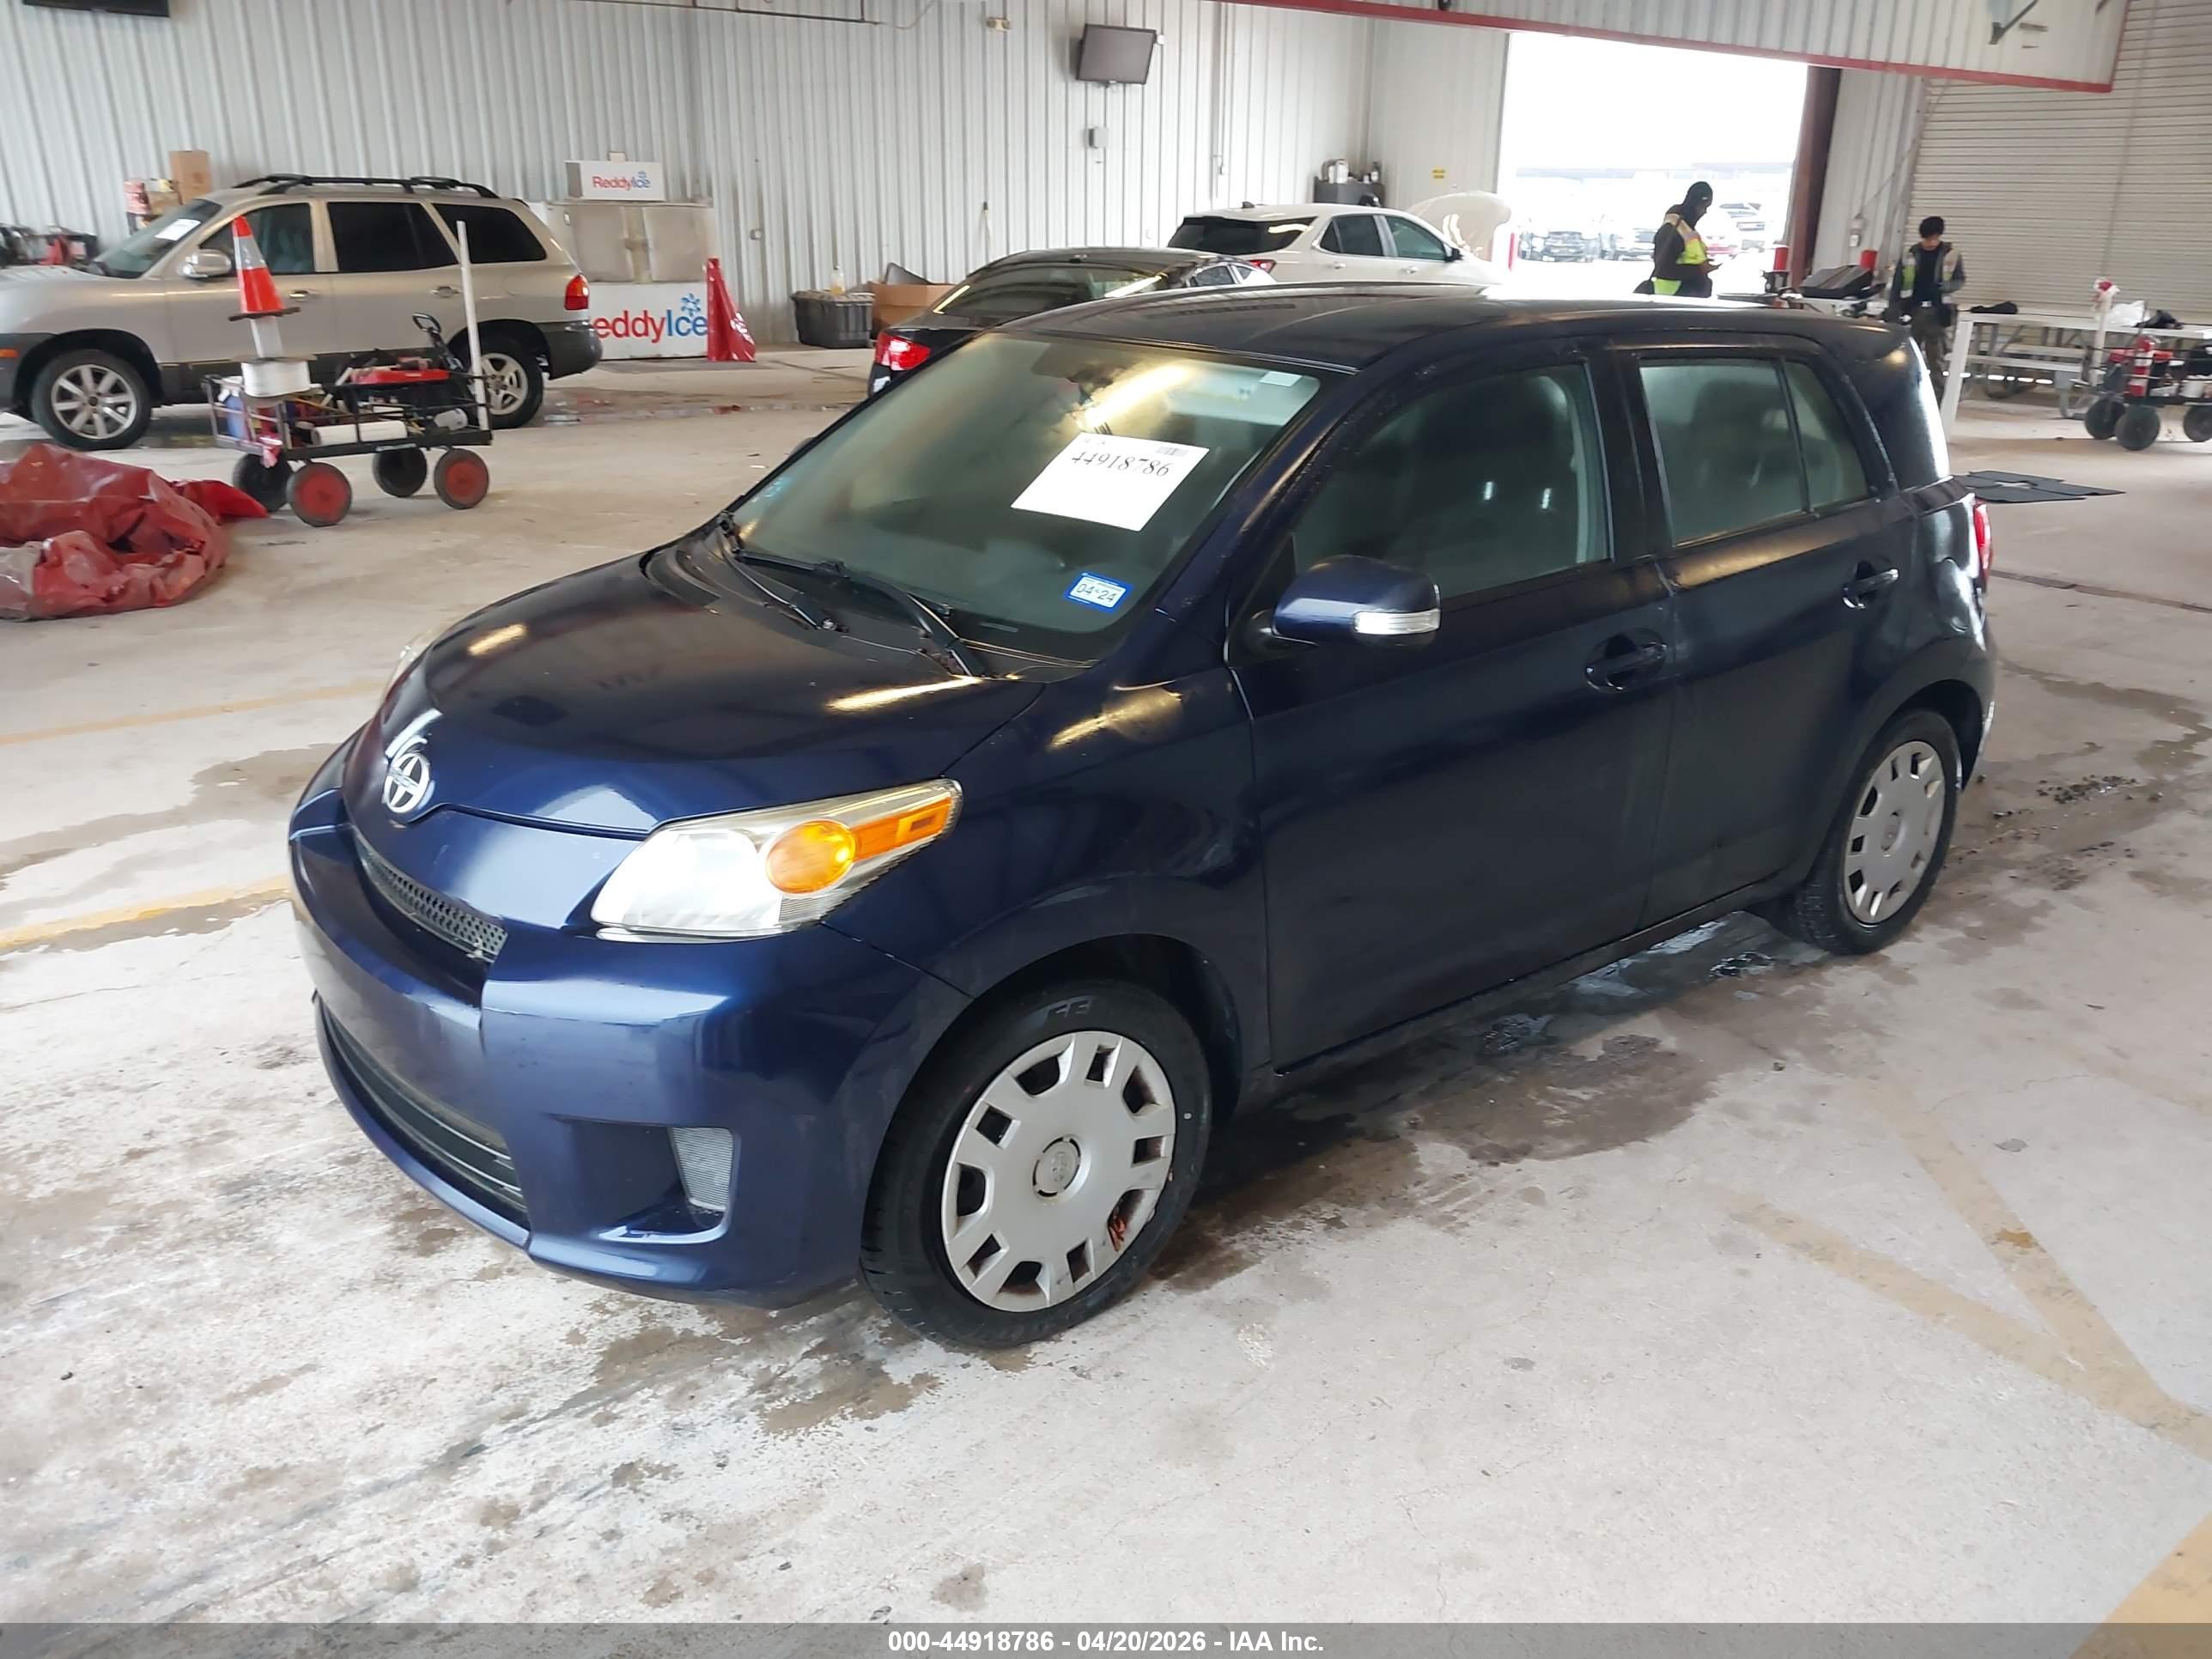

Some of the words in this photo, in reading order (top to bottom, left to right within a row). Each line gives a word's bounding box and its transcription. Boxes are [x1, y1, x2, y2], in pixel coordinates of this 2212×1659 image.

[592, 175, 651, 191] ReddyIce
[592, 310, 708, 343] eddyIce
[1071, 451, 1170, 477] 44918786
